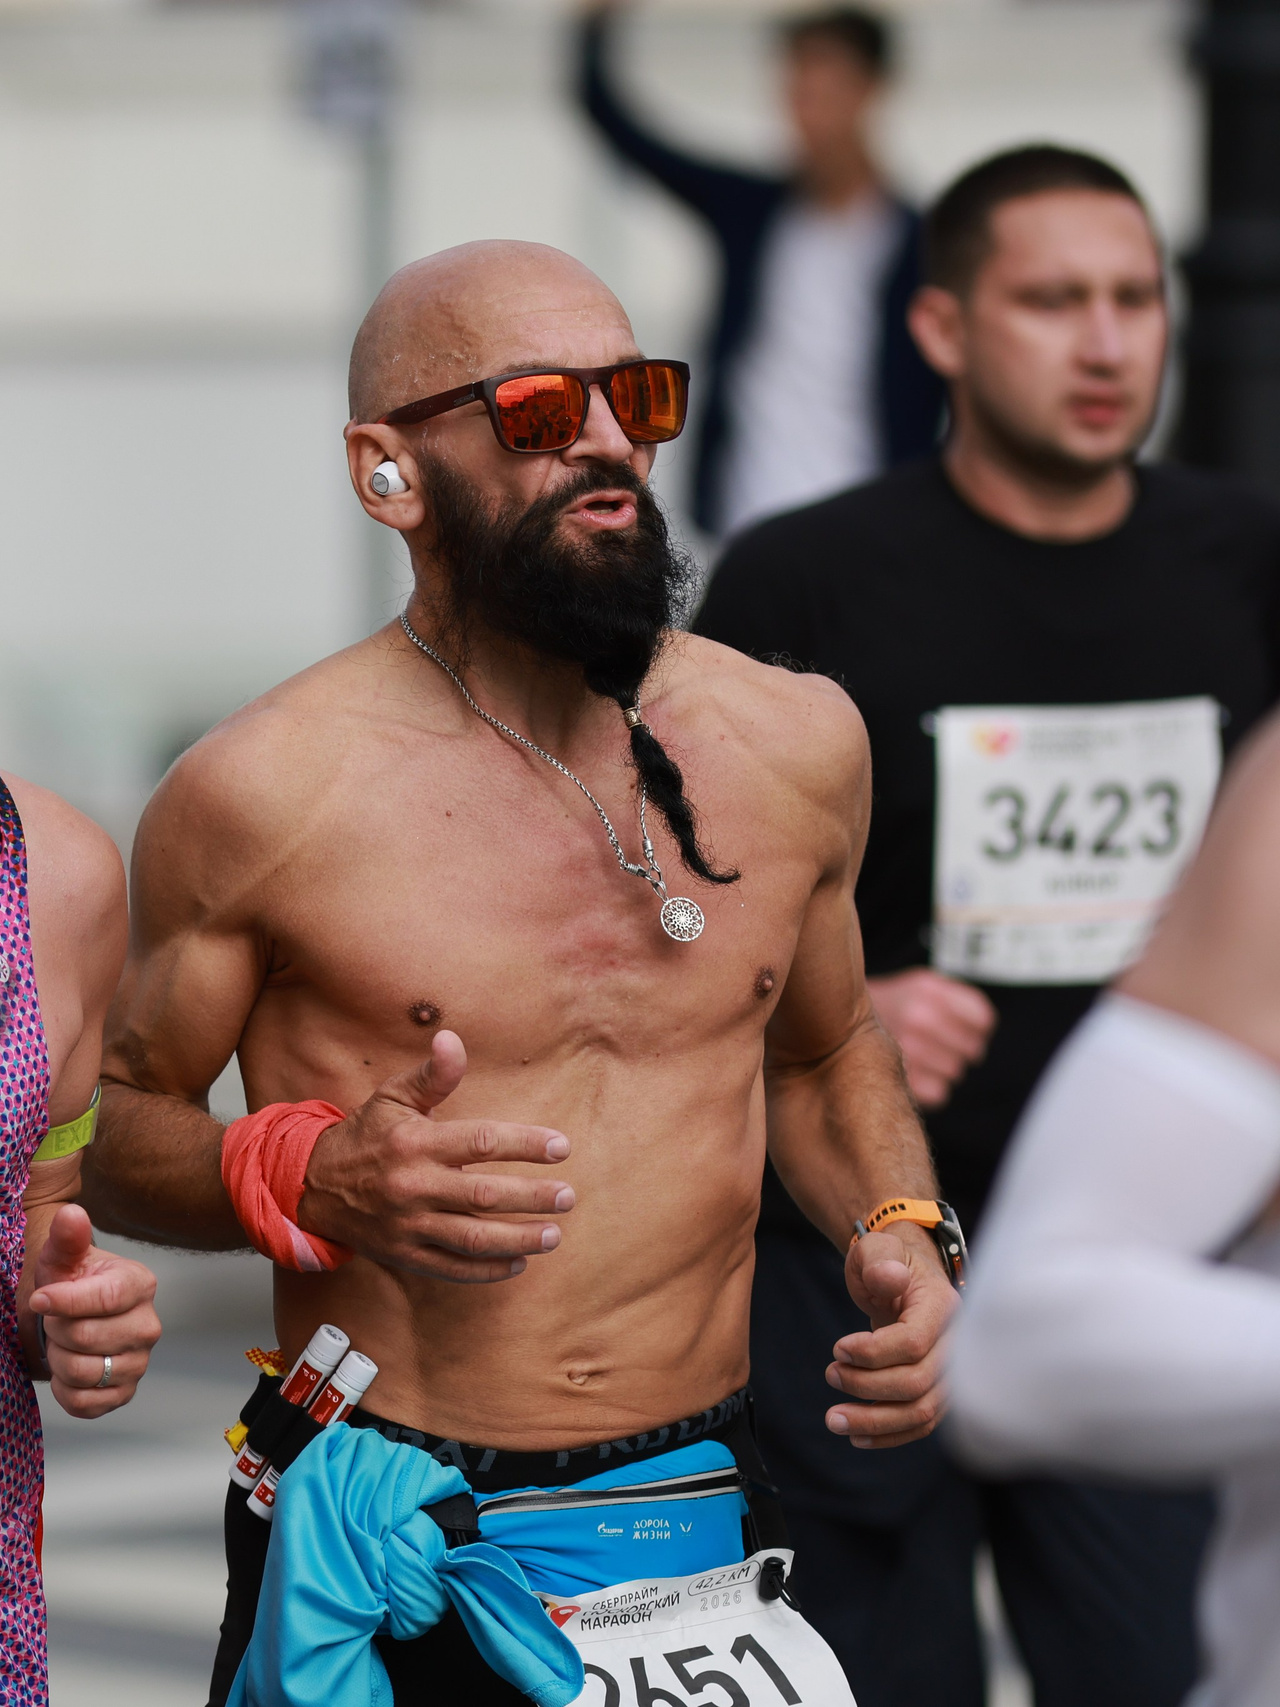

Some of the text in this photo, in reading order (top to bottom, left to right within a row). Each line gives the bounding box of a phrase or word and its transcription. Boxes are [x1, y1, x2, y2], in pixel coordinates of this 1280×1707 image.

[983, 780, 1182, 863] 3423
[633, 1519, 670, 1528] ДОРОГА
[633, 1530, 671, 1540] ЖИЗНИ
[695, 1573, 727, 1592] 42,2
[593, 1586, 658, 1610] СБЕРПРАЙМ
[581, 1611, 652, 1631] МАРАФОН
